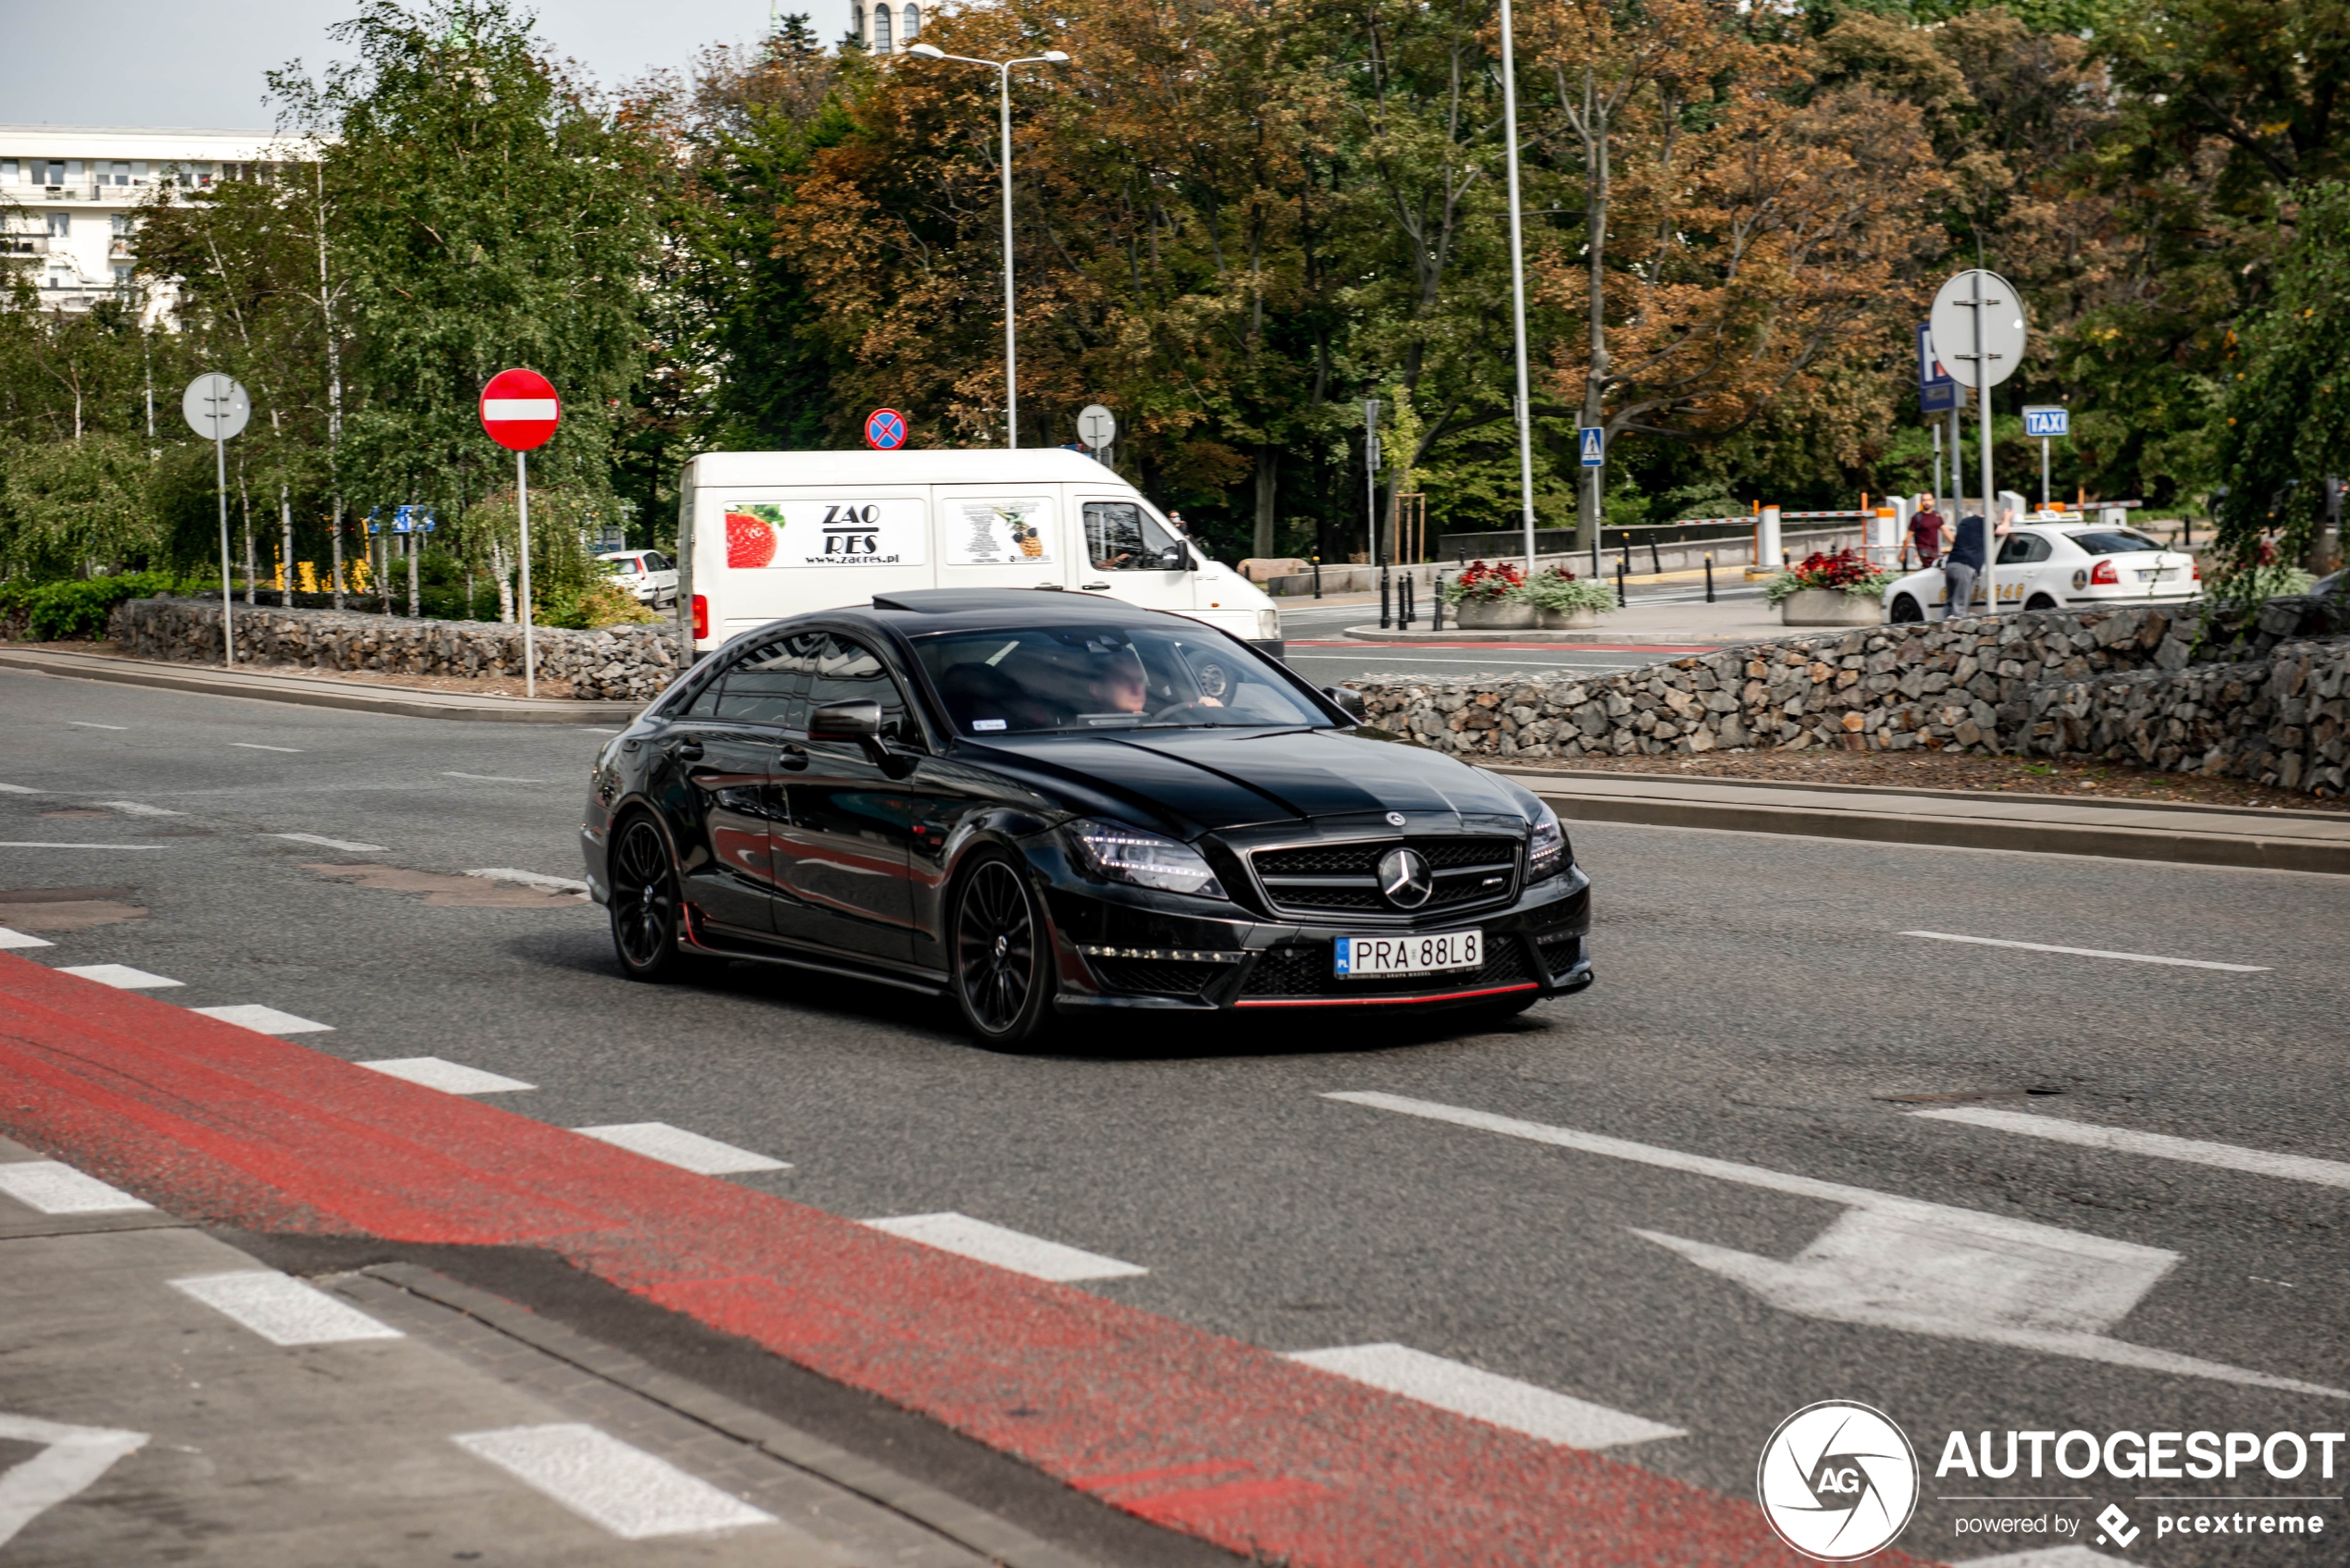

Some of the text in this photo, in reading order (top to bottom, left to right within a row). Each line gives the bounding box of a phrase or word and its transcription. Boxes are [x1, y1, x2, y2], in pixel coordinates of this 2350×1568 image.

[2029, 413, 2067, 433] TAXI
[822, 504, 880, 524] ZAO
[824, 535, 878, 554] RES
[1356, 934, 1477, 969] PRA 88L8
[1337, 958, 1349, 969] PL
